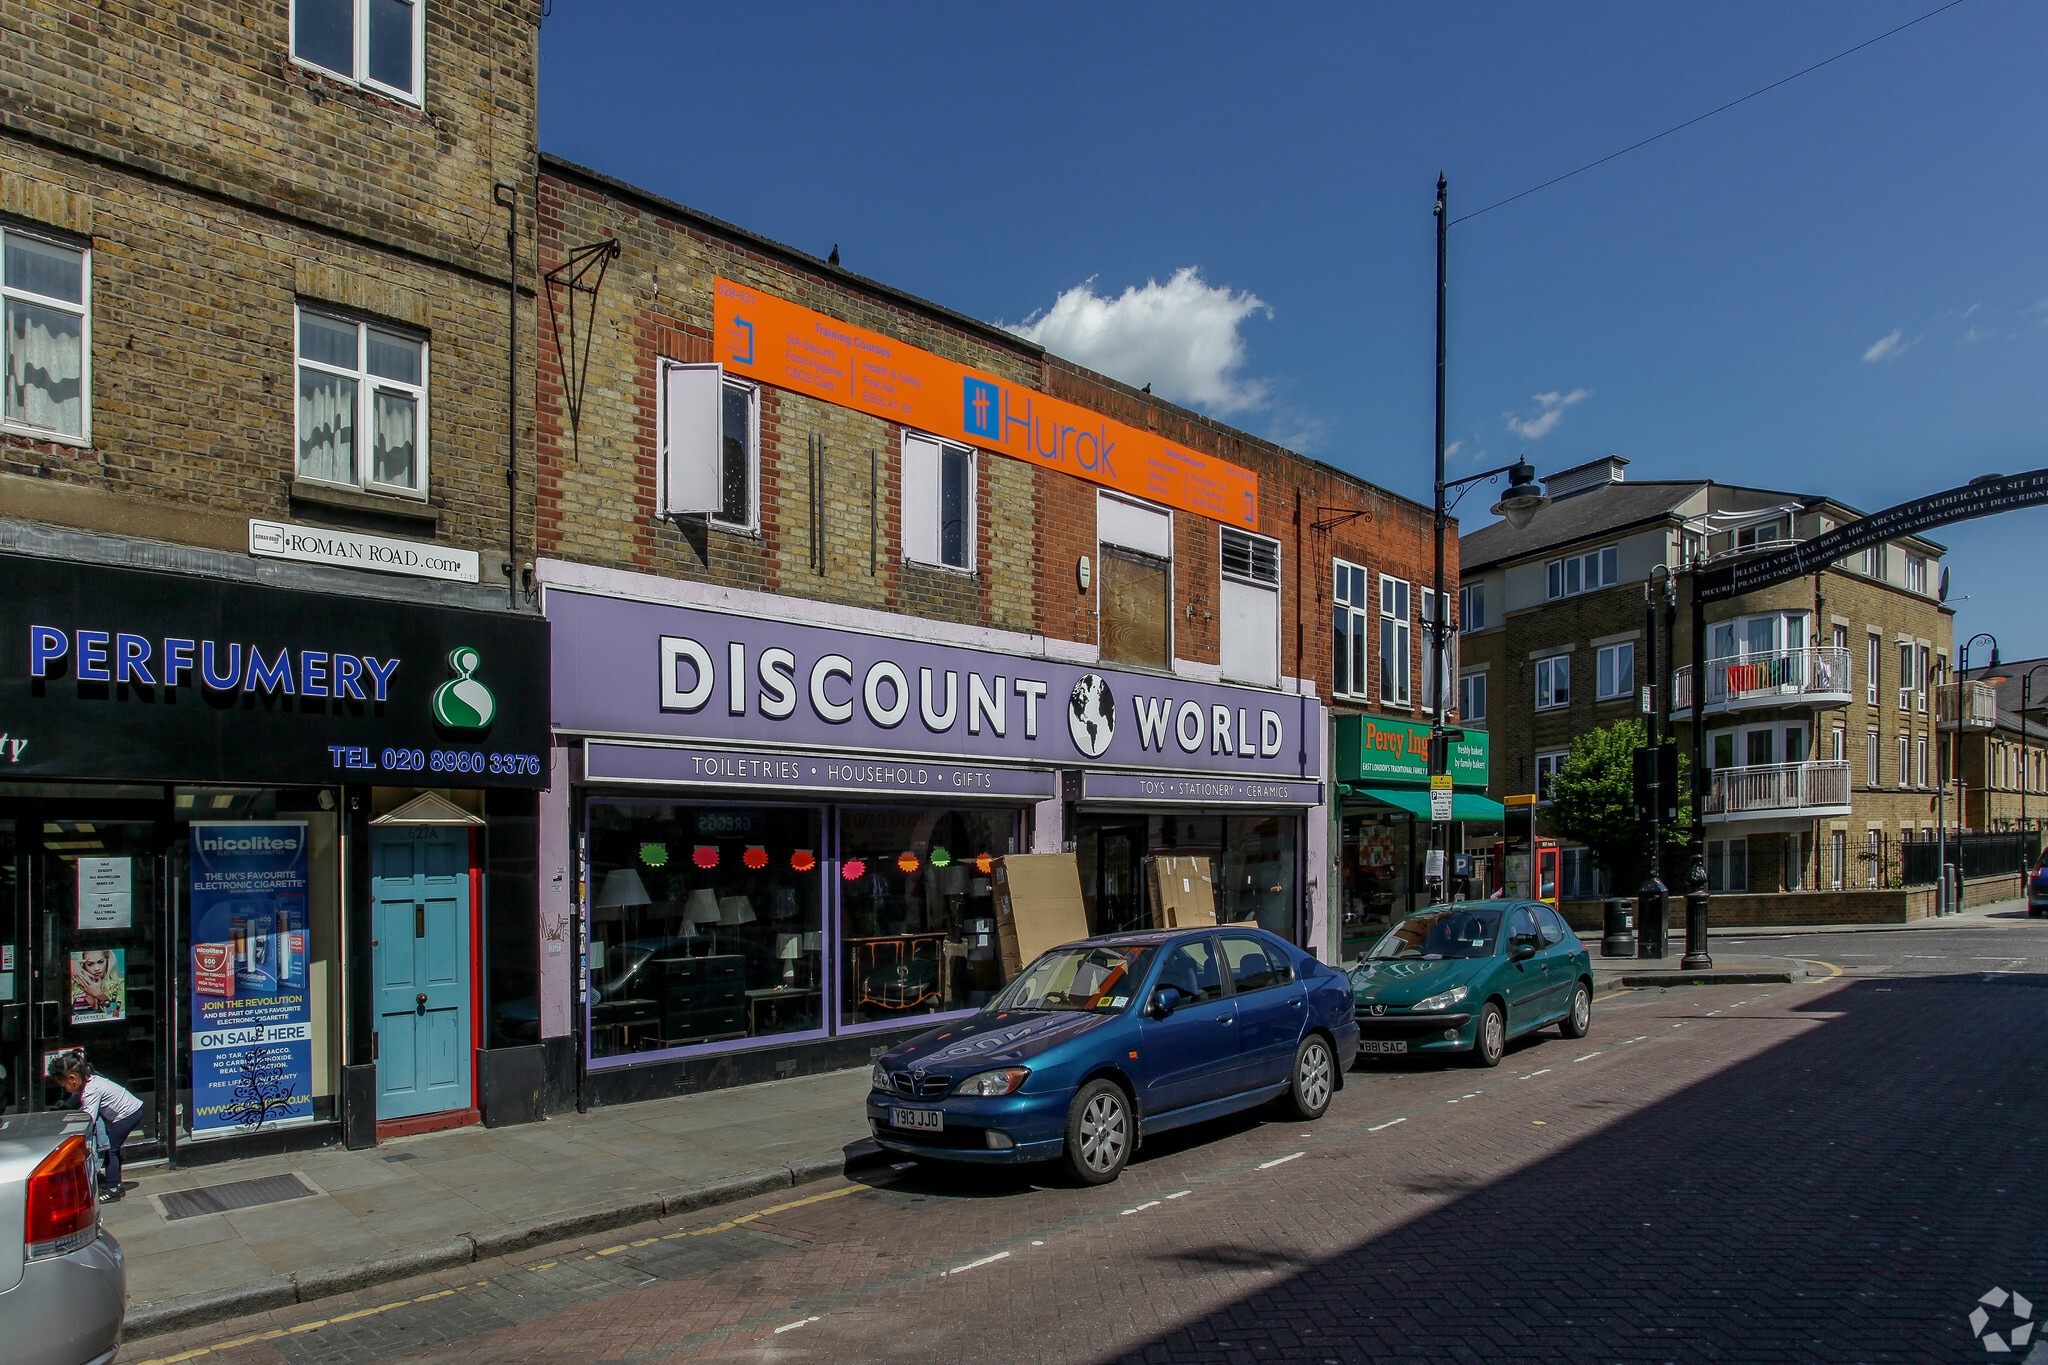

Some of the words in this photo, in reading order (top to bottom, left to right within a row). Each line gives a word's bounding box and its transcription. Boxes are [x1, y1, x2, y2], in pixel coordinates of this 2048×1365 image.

[804, 339, 837, 362] Security
[815, 322, 852, 347] Training
[854, 336, 891, 359] Courses
[786, 350, 808, 366] Food
[810, 357, 843, 379] Hygiene
[786, 366, 812, 384] CSCS
[814, 376, 835, 391] Card
[863, 360, 888, 377] Health
[891, 369, 897, 380] &
[899, 371, 922, 390] Safety
[863, 376, 881, 390] First
[883, 383, 895, 395] Aid
[1005, 389, 1117, 479] Hurak
[1735, 562, 1770, 577] DELECTI
[1820, 533, 1842, 548] BOW
[1848, 525, 1865, 537] HIC
[1870, 511, 1904, 529] ARCUS
[1908, 506, 1923, 515] UT
[1927, 484, 2001, 510] AEDIFICATUS
[2007, 480, 2026, 491] SIT
[2032, 477, 2048, 486] EF
[291, 535, 362, 559] ROMAN
[1738, 564, 1800, 588] PRAEFECTAQUE
[1840, 527, 1895, 552] PRAEFECTUS
[1898, 514, 1942, 530] VICARIUS
[31, 625, 400, 701] PERFUMERY
[659, 634, 1048, 740] DISCOUNT
[1132, 695, 1283, 759] WORLD
[1365, 722, 1404, 760] Percy
[1407, 728, 1433, 762] Ing
[1457, 744, 1470, 757] freshly
[1471, 746, 1483, 756] baked
[328, 746, 376, 769] TEL
[382, 748, 425, 770] 020
[429, 750, 485, 773] 8980
[489, 753, 540, 774] 3376
[1362, 763, 1372, 771] EAST
[1372, 763, 1390, 772] LONDON'S
[1390, 764, 1412, 774] TRADITIONAL
[1413, 766, 1424, 774] FAMILY
[1455, 758, 1460, 769] by
[1460, 758, 1472, 770] family
[1473, 760, 1485, 769] bakers
[691, 757, 799, 779] TOILETRIES
[828, 764, 928, 785] HOUSEHOLD
[952, 772, 991, 788] GIFTS
[1140, 781, 1165, 794] TOYS
[1179, 783, 1235, 797] STATIONERY
[1246, 785, 1288, 798] CERAMICS
[203, 836, 297, 851] nicolites
[408, 827, 438, 840] 627A
[1456, 858, 1466, 873] P
[194, 881, 252, 890] ELECTRONIC
[205, 873, 223, 881] THE
[225, 872, 246, 880] UK'S
[247, 871, 296, 880] FAVOURITE
[237, 973, 266, 981] nicolites
[202, 1002, 224, 1011] JOIN
[226, 1000, 243, 1008] THE
[245, 995, 303, 1007] REVOLUTION
[269, 1005, 301, 1013] FAVOURITE
[217, 1017, 255, 1025] ELECTRONIC
[200, 1033, 223, 1047] ON
[227, 1029, 264, 1045] SALE
[268, 1026, 305, 1041] HERE
[1359, 1041, 1380, 1051] W881
[1382, 1041, 1403, 1052] SAC
[894, 1109, 915, 1125] Y913
